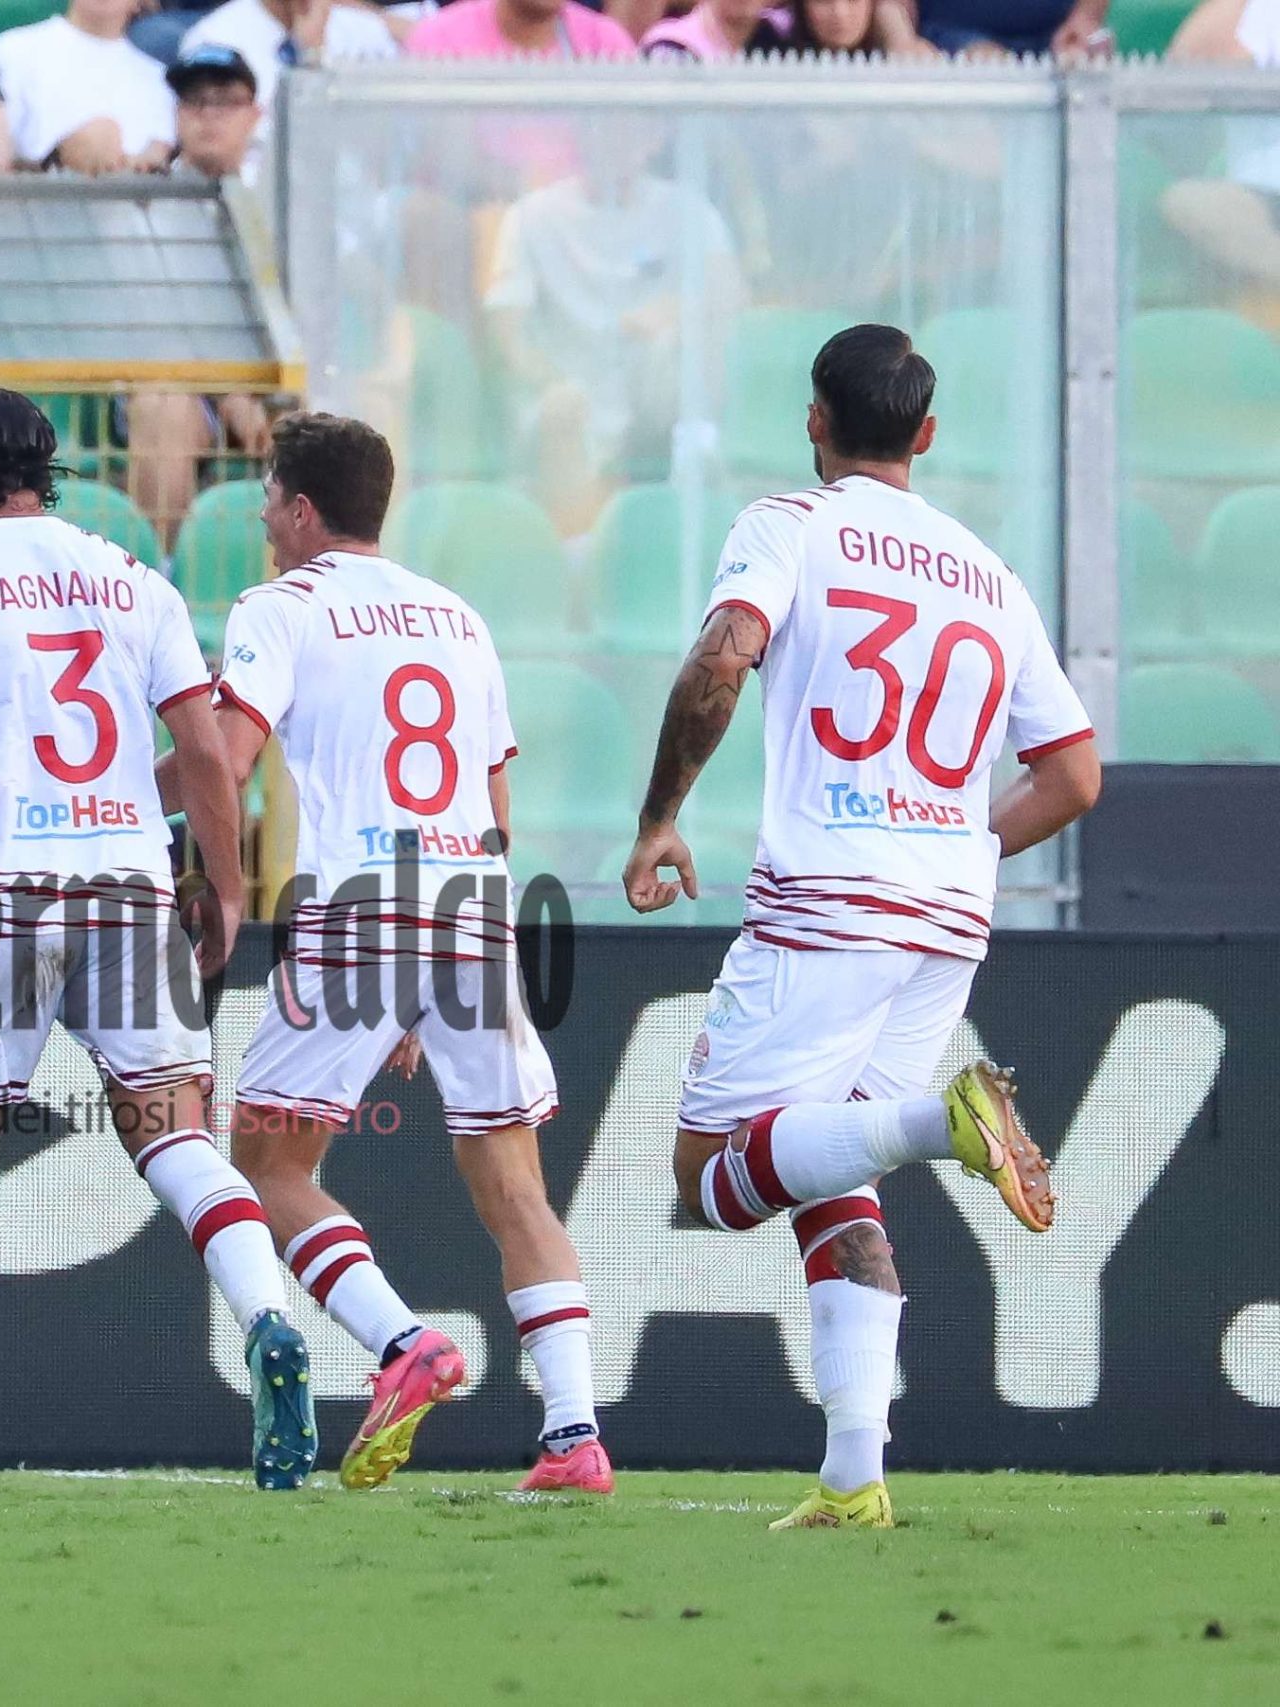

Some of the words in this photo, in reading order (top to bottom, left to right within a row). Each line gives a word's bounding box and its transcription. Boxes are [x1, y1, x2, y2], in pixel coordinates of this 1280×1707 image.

[328, 603, 478, 645] LUNETTA
[838, 527, 1004, 610] GIORGINI
[26, 630, 118, 784] 3
[383, 663, 458, 816] 8
[810, 587, 1006, 789] 30
[356, 823, 497, 858] TopHau
